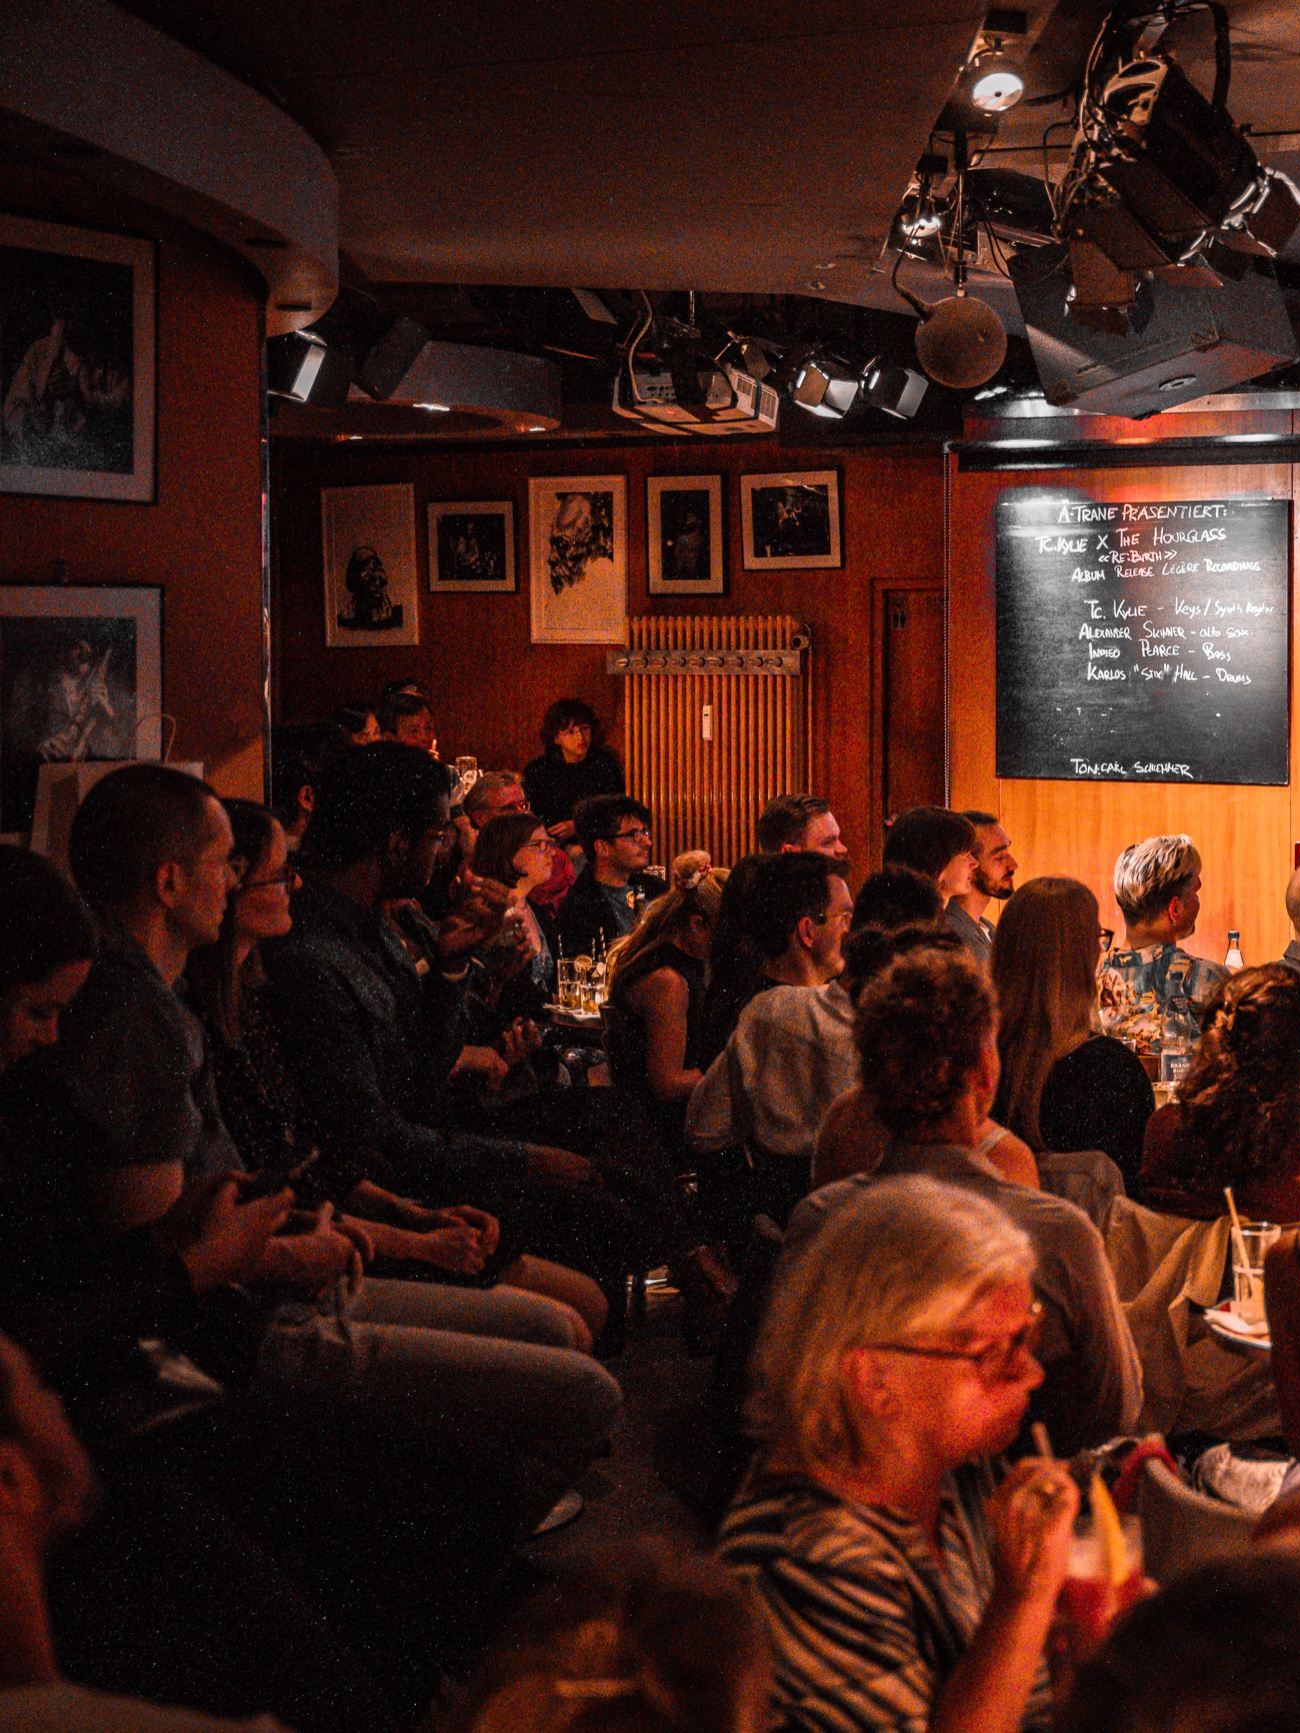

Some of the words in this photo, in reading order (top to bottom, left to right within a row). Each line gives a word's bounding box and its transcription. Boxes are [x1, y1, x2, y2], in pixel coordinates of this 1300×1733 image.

[1058, 505, 1119, 523] A-TRANE
[1116, 527, 1140, 548] THE
[1153, 527, 1227, 546] HOURGLASS
[1071, 567, 1105, 583] ALBUM
[1114, 565, 1155, 578] RELEASE
[1203, 558, 1261, 573] RECORDINGS
[1079, 623, 1132, 641] ALEXANDER
[1086, 661, 1127, 681] KARLOS
